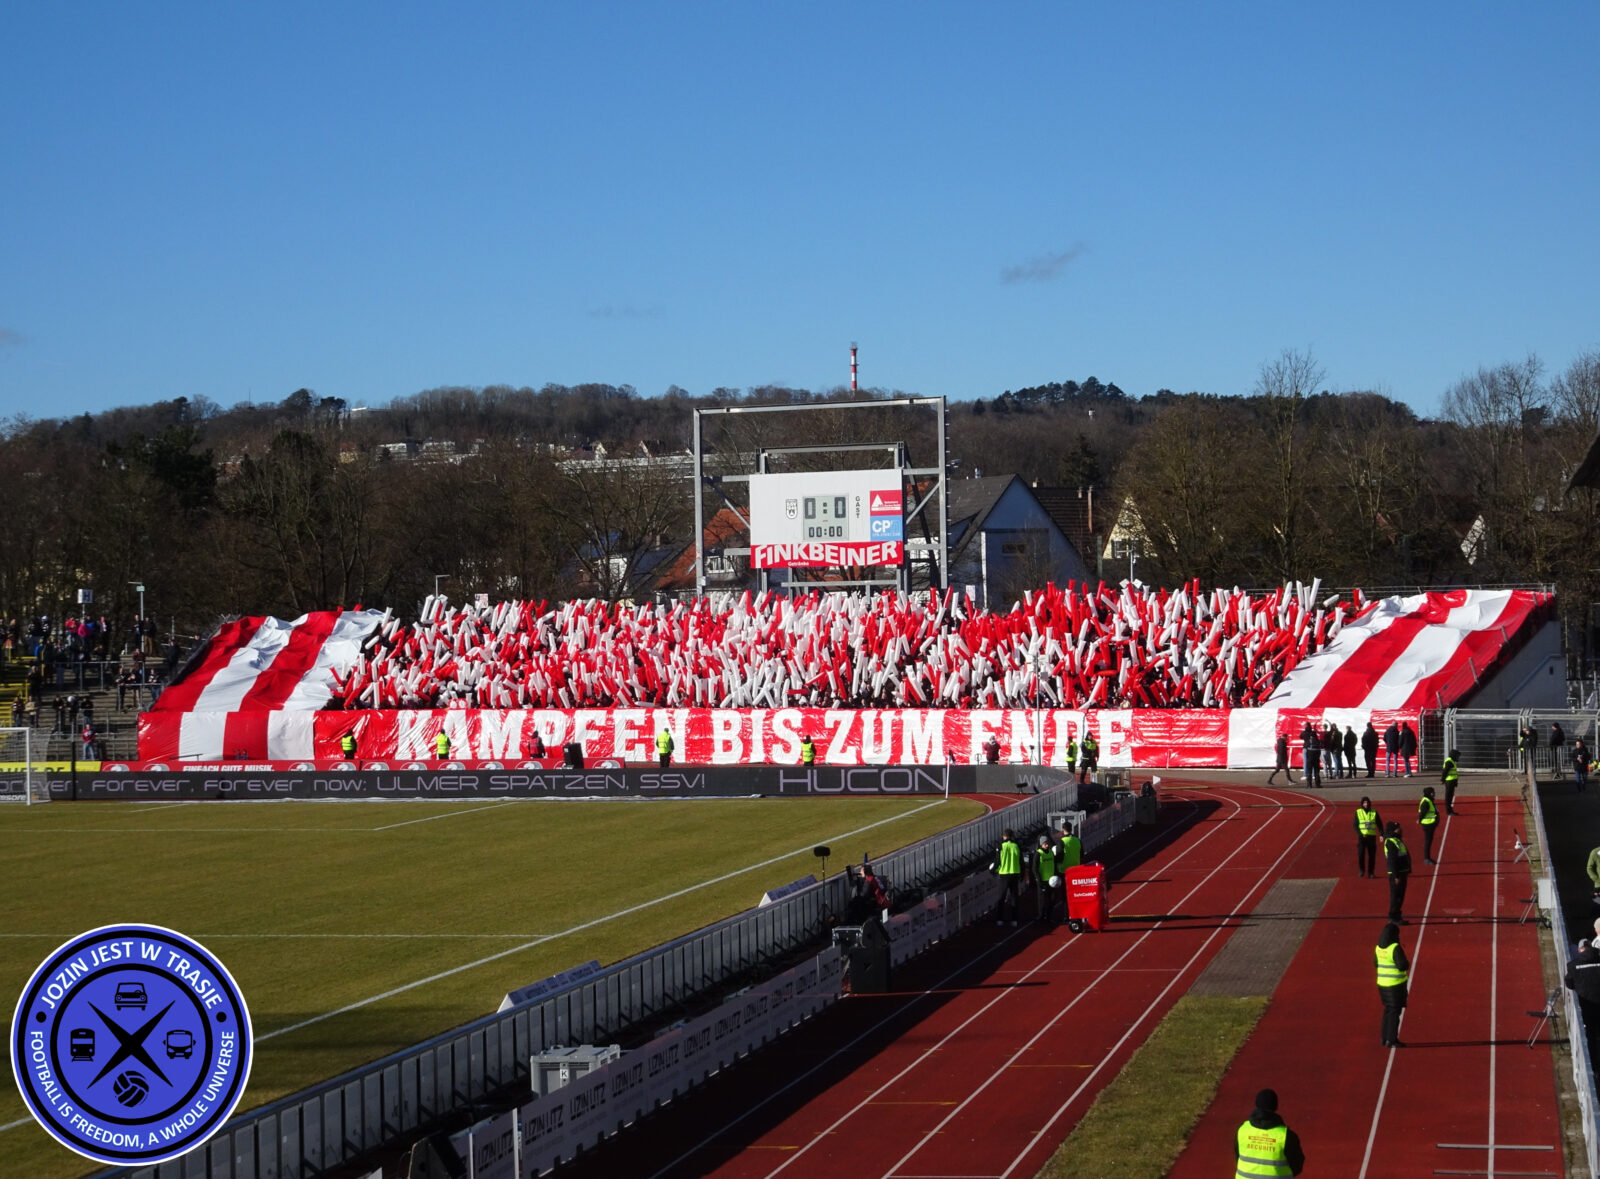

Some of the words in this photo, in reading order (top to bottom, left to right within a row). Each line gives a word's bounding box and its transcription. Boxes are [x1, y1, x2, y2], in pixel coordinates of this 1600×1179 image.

[755, 541, 898, 568] FINKBEINER
[710, 709, 801, 764] BIS
[824, 710, 945, 765] ZUM
[969, 709, 1133, 767] ENDE
[377, 776, 479, 791] ULMER
[489, 775, 629, 791] SPATZEN,
[640, 774, 705, 789] SSV!
[780, 768, 947, 792] HUCON
[1077, 877, 1098, 885] MUNK
[561, 1070, 568, 1078] K
